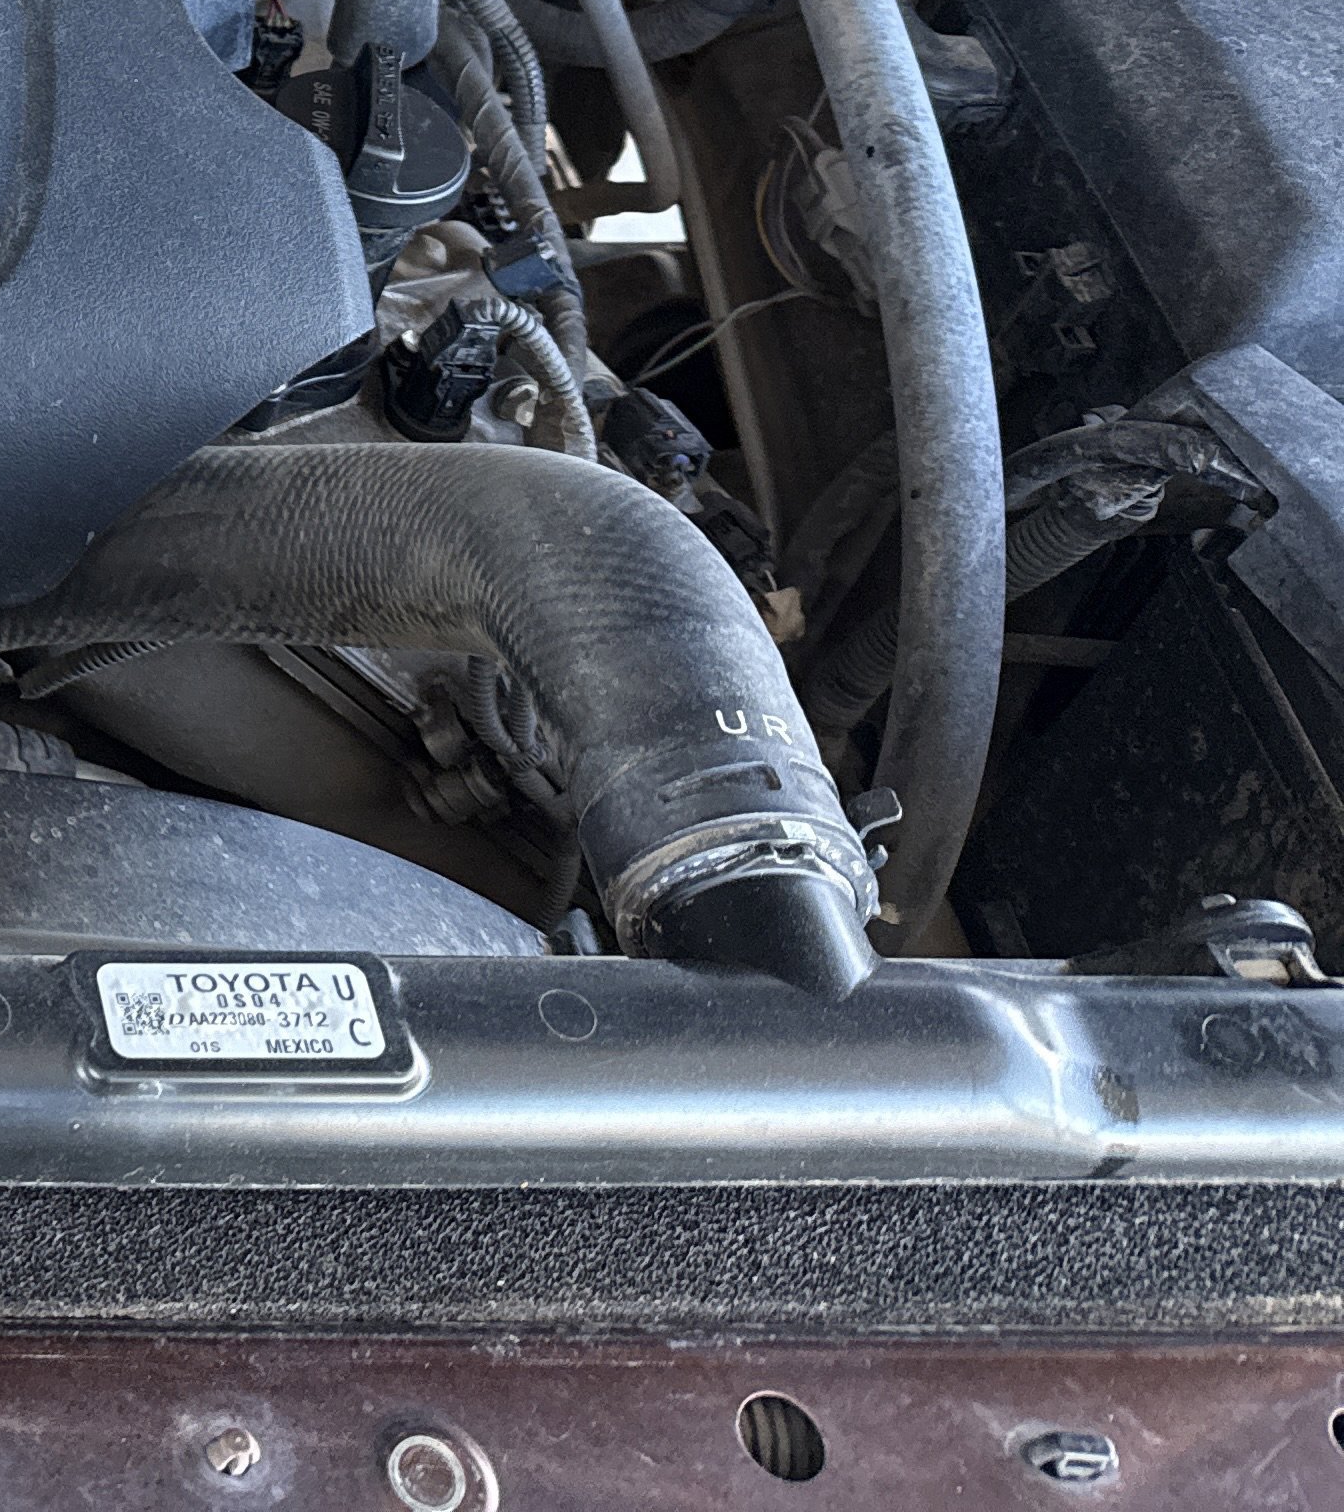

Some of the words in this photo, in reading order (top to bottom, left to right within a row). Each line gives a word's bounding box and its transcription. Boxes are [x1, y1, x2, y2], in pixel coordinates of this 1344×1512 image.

[313, 82, 333, 105] SAE
[166, 973, 320, 993] TOYOTA
[332, 974, 355, 1001] U
[349, 1018, 372, 1047] C
[265, 1039, 334, 1054] MEXICO
